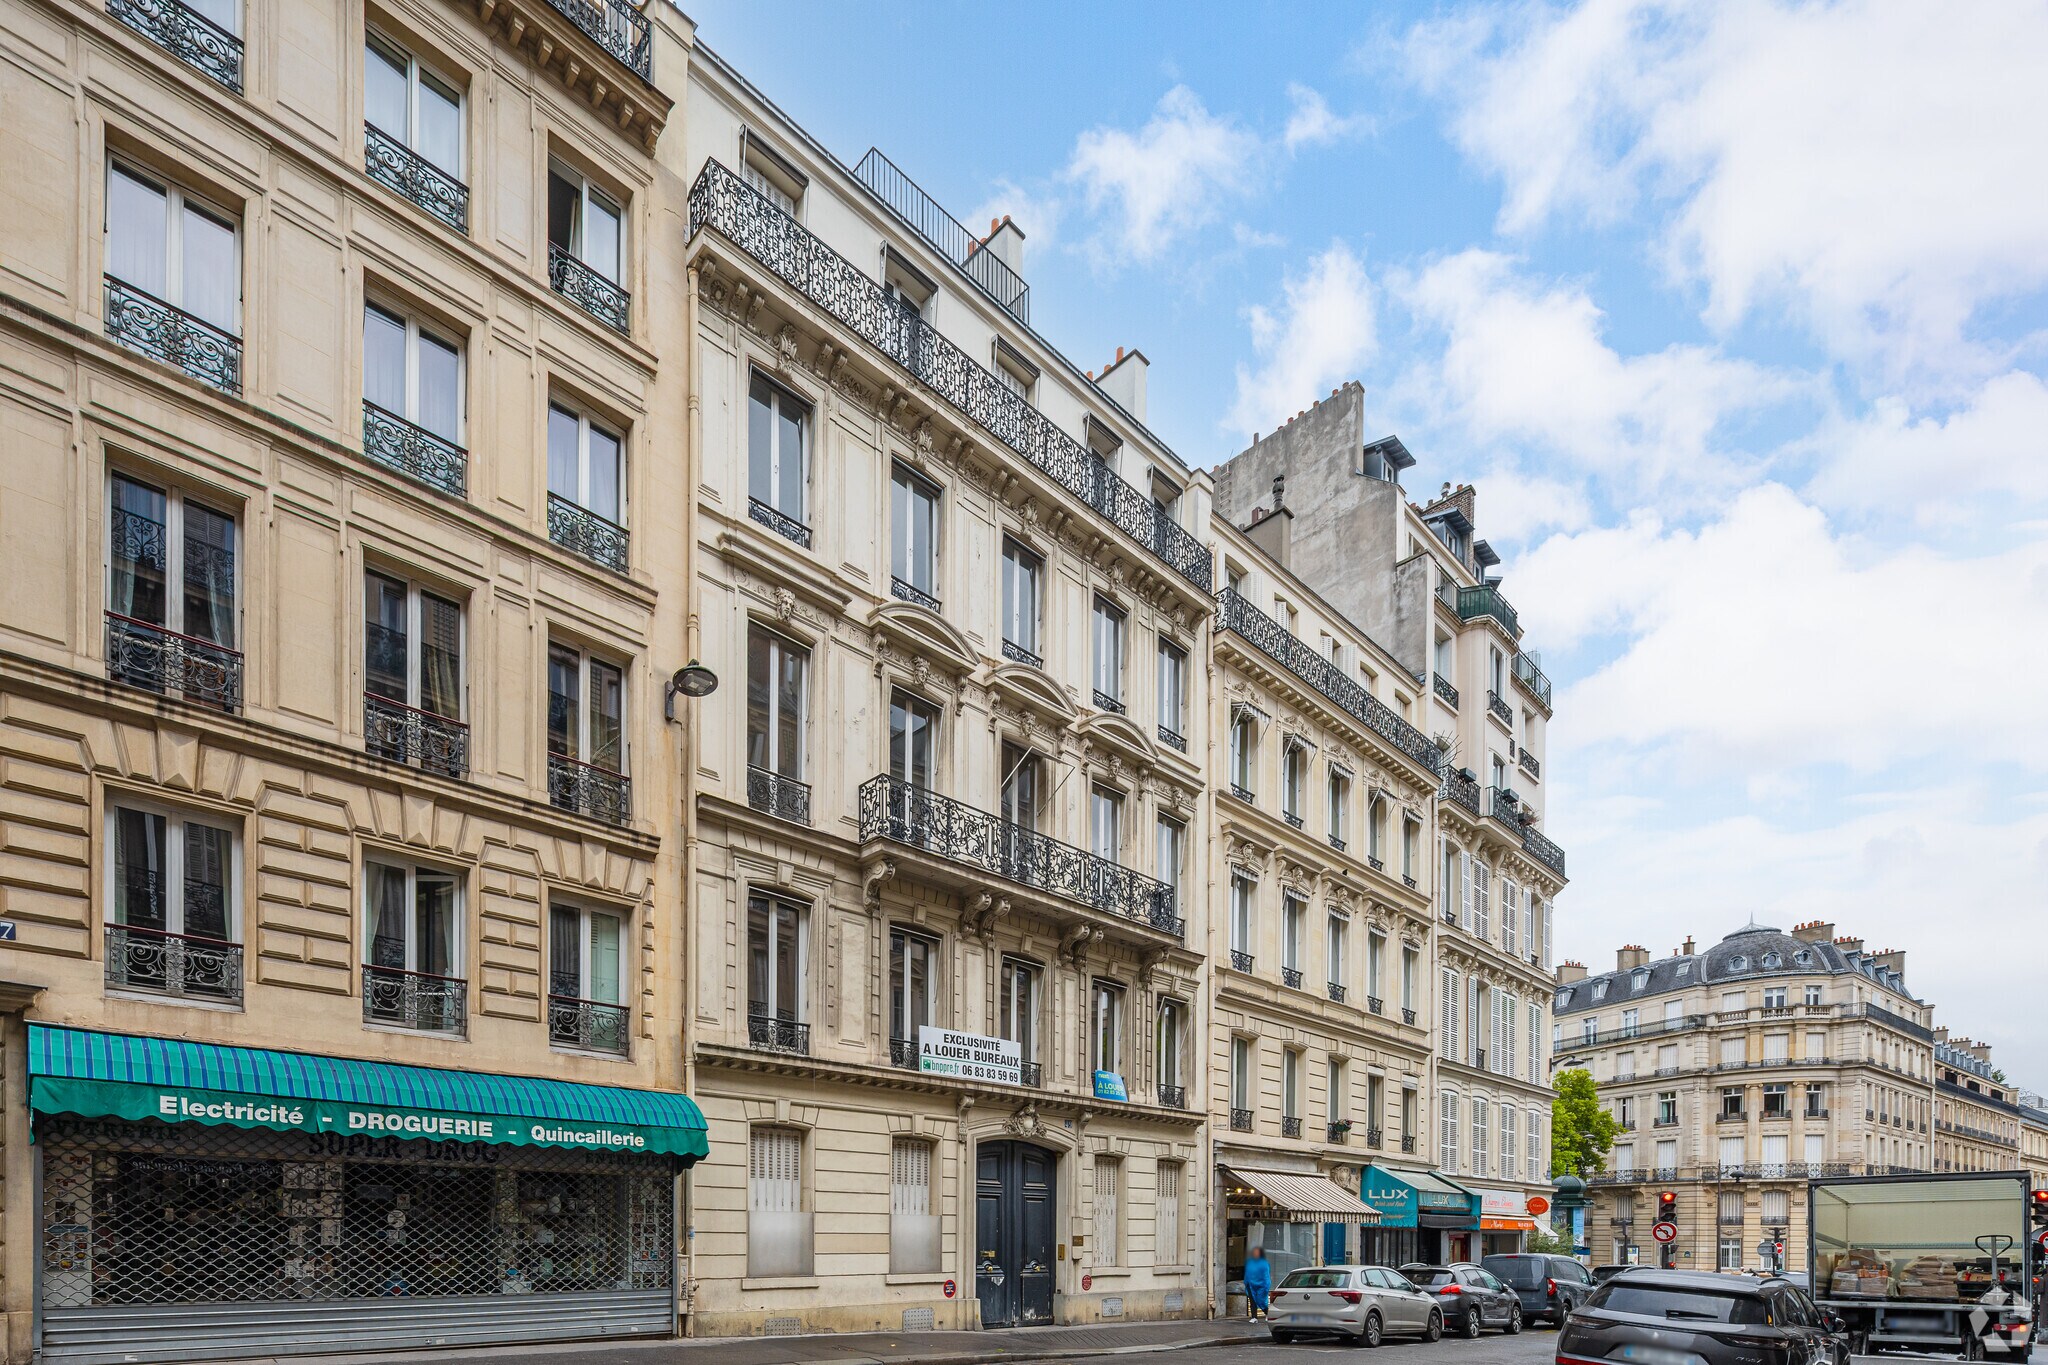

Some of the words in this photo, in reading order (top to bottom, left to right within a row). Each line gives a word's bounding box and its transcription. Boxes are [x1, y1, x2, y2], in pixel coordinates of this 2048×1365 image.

[0, 922, 14, 939] 7
[943, 1033, 1001, 1052] EXCLUSIVITÉ
[923, 1043, 931, 1054] A
[935, 1044, 970, 1060] LOUER
[974, 1050, 1020, 1068] BUREAUX
[931, 1060, 960, 1075] bnppre.fr
[962, 1064, 973, 1076] 06
[974, 1066, 985, 1078] 83
[986, 1068, 996, 1080] 83
[997, 1070, 1007, 1081] 59
[1009, 1071, 1018, 1083] 69
[160, 1094, 304, 1125] Electricité
[348, 1111, 493, 1137] DROGUERIE
[530, 1125, 645, 1147] Quincaillerie
[309, 1134, 402, 1158] SUPER
[1368, 1189, 1409, 1199] LUX
